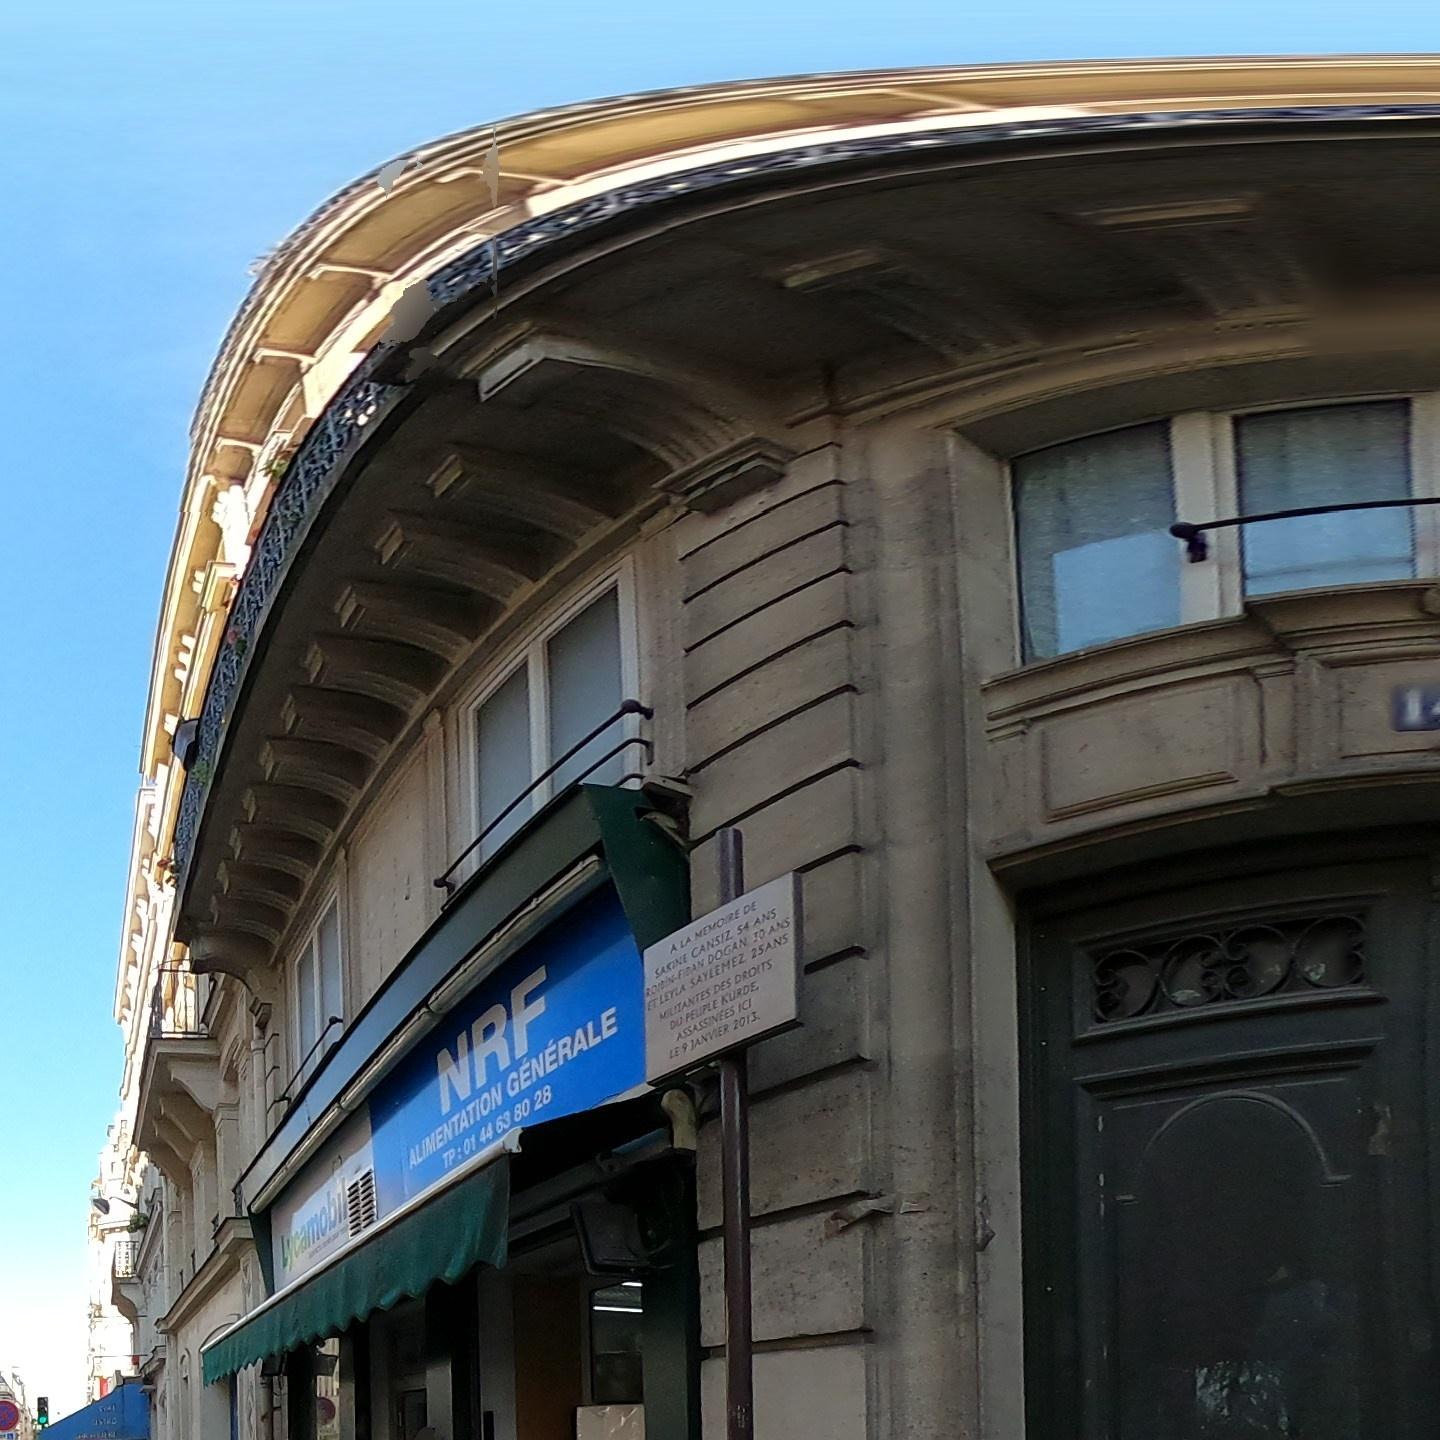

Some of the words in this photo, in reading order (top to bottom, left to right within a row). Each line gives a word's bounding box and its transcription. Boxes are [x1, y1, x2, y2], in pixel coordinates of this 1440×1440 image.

[680, 937, 690, 951] LA
[743, 901, 757, 916] DE
[753, 908, 777, 925] ANS
[768, 916, 791, 937] ANS
[713, 976, 732, 994] DES
[734, 958, 773, 985] DROITS
[670, 1016, 683, 1031] DU
[685, 1000, 718, 1026] PEUPLE
[737, 998, 753, 1013] ICI
[437, 964, 548, 1117] NRF
[689, 1023, 730, 1052] JANVIER
[409, 1082, 503, 1170] ALIMENTATION
[507, 1006, 618, 1099] GÉNÉRALE
[464, 1134, 476, 1154] 01
[480, 1122, 493, 1144] 44
[495, 1112, 511, 1133] 63
[514, 1099, 529, 1119] 80
[534, 1085, 552, 1112] 28
[281, 1176, 347, 1272] Lycamobil
